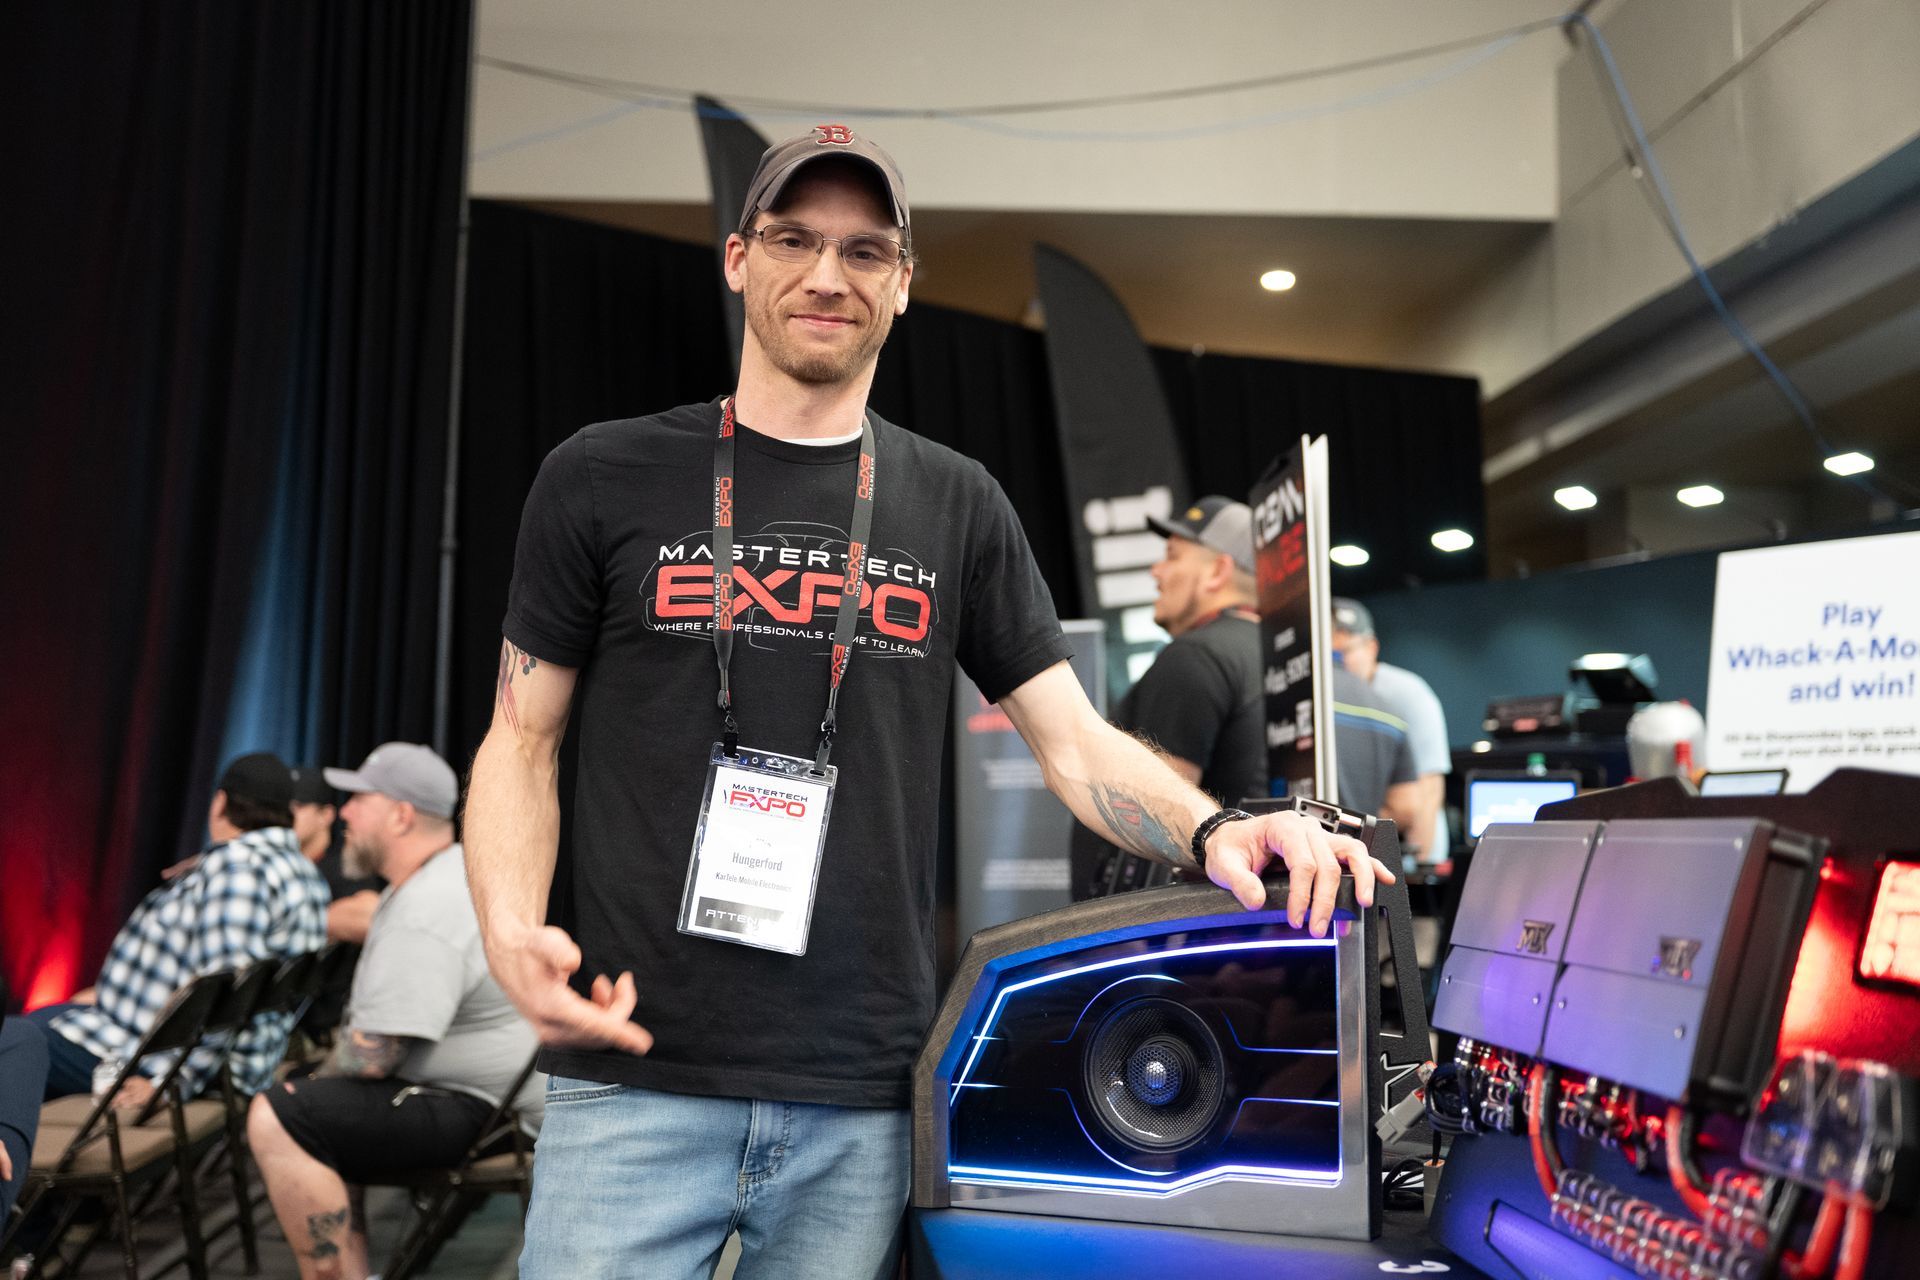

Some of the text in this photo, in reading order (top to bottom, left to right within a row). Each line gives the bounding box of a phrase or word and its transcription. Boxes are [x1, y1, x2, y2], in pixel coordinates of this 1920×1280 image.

[814, 125, 855, 145] B
[858, 453, 871, 499] EXPO
[867, 457, 875, 501] MASTERTECH
[720, 477, 732, 527] EXPO
[844, 542, 862, 596] EXPO
[855, 544, 867, 598] MASTERTECH
[655, 565, 931, 641] EXPO
[720, 573, 732, 630] EXPO
[1822, 603, 1881, 628] Play
[654, 622, 925, 659] WHERE PFESSIONALS CE TO LEARN
[1727, 636, 1920, 670] Whack-A-Mo
[832, 644, 845, 689] EXP
[1789, 672, 1915, 702] and win!
[730, 790, 805, 818] EXPO
[732, 784, 808, 802] MASTERTECH
[732, 851, 783, 871] Hungerford
[705, 909, 758, 927] ATTEN
